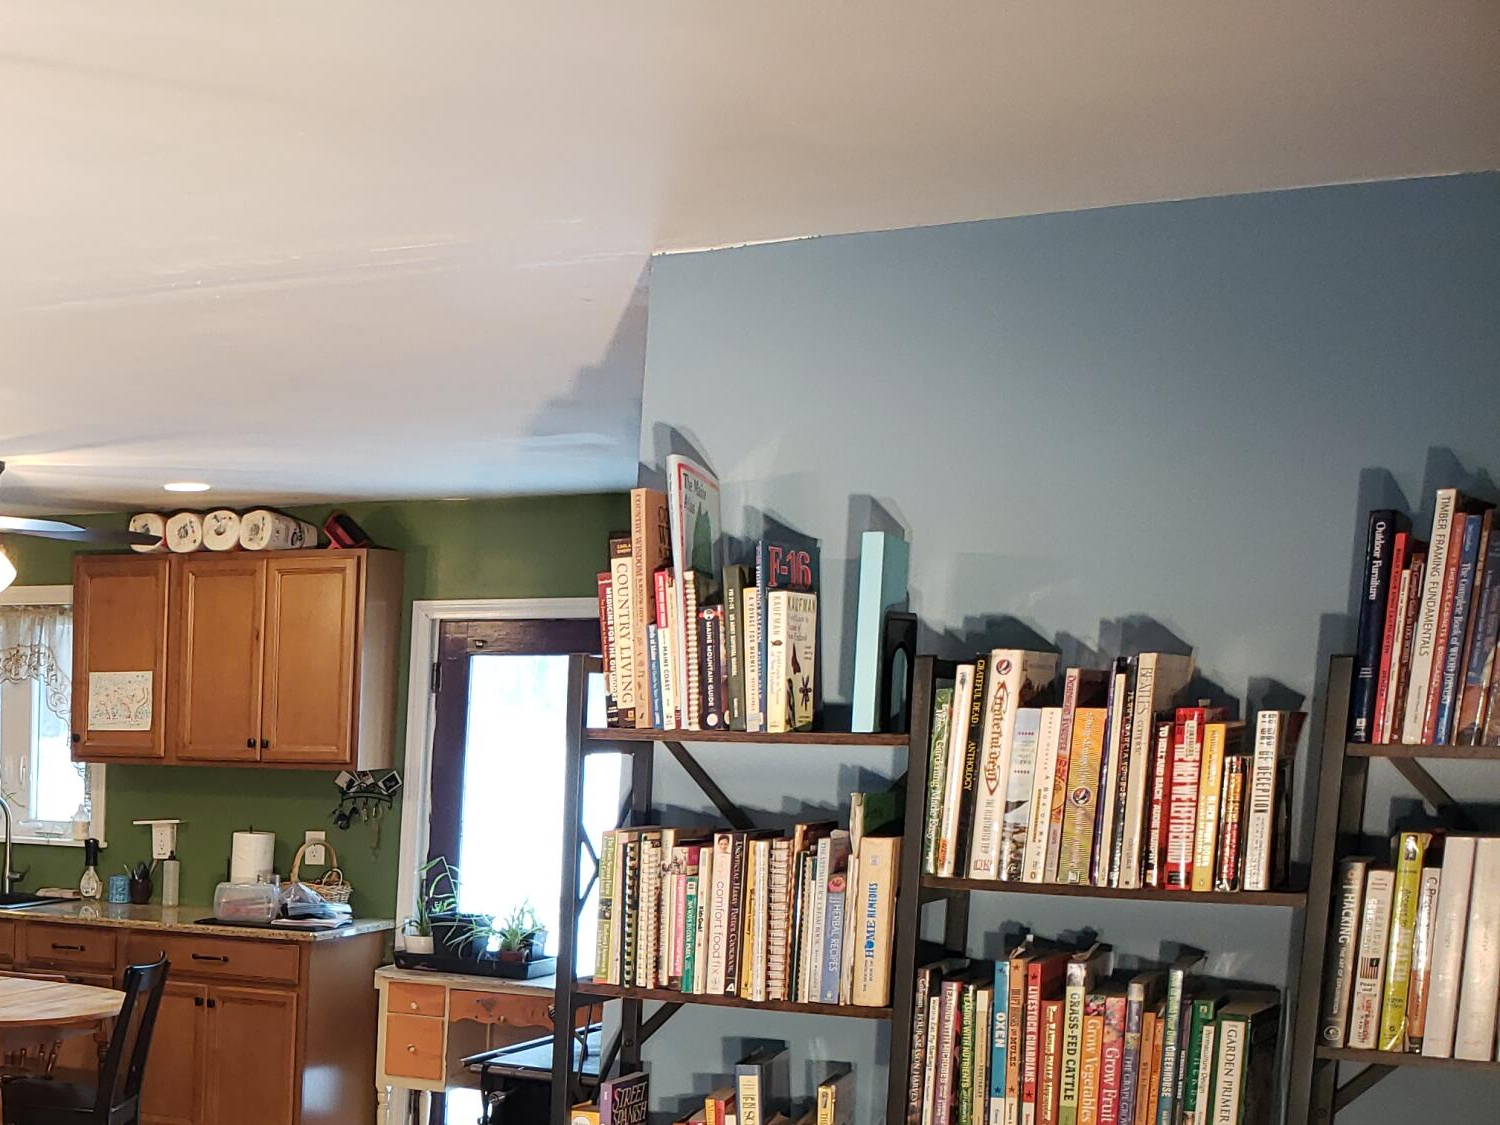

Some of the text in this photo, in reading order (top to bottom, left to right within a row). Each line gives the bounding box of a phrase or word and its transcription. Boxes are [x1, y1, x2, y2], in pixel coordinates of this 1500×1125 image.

[634, 494, 643, 576] COUNTRY WISDOM
[768, 546, 811, 587] F-16
[1368, 522, 1386, 600] Outdoor Furniture
[788, 595, 815, 612] KAUFMAN
[1419, 496, 1452, 658] TIMBER FRAMING FUNDAMENTALS
[1440, 567, 1456, 637] SHELVES, CABINETS
[606, 587, 615, 638] MEDICINE FOR
[617, 563, 634, 704] COUNTRY LIVING
[772, 595, 780, 636] KAUFMAN
[1403, 625, 1413, 663] LOG HOMES
[1442, 563, 1470, 706] The Complete Book of WOOD JOINERY
[963, 660, 985, 790] GRATEFUL DEAD ANTHOLOGY
[1060, 717, 1071, 751] FOREVER
[1134, 668, 1153, 755] BEATLES complete
[1154, 725, 1169, 800] TO HELL AND BACK
[1258, 750, 1272, 761] OF
[926, 740, 945, 840] Gardening Made Easy
[1168, 743, 1200, 863] THE MEN WE LEFT BEHIND
[1254, 766, 1271, 814] DECEPTION
[980, 799, 995, 854] THE ILLUSTRATED TRIP
[1149, 805, 1162, 865] AUDIE MURPHY
[1201, 795, 1217, 867] BLACK HAWK DOWN
[818, 856, 826, 888] ULTIMATE
[712, 881, 726, 974] comfort food fix
[727, 840, 743, 974] UNOFFICIAL HARRY POTTER COOKBOOK
[828, 904, 842, 972] HERBAL RECIPES
[864, 882, 879, 958] HOME REMEDIES
[1338, 893, 1355, 944] HACKING
[1363, 898, 1378, 954] GOVERNMENT
[1332, 978, 1342, 1014] EXPLOITATION
[1337, 968, 1343, 976] OF
[910, 979, 927, 1107] Coleman HARVEST
[927, 1045, 935, 1071] Garbage
[939, 985, 955, 1083] TEAMING WITH MICROBES
[961, 992, 973, 1088] TEAMING WITH NUTRIENTS
[995, 1012, 1005, 1047] OXEN
[1009, 1037, 1017, 1067] MULES
[1025, 986, 1038, 1083] LIVESTOCK GUARDIANS
[1064, 992, 1079, 1102] GRASS-FED CATTLE
[1199, 1029, 1212, 1094] Permaculture Design
[613, 1082, 647, 1110] STREET
[1081, 1019, 1102, 1122] Grow Vegetables
[1100, 1047, 1119, 1123] Grow Fruit
[1121, 1073, 1131, 1102] GRAPE
[1123, 1056, 1133, 1072] THE
[1160, 1046, 1176, 1098] GREENHOUSE
[1219, 1029, 1237, 1123] GARDEN PRIMER
[820, 1113, 828, 1125] THE
